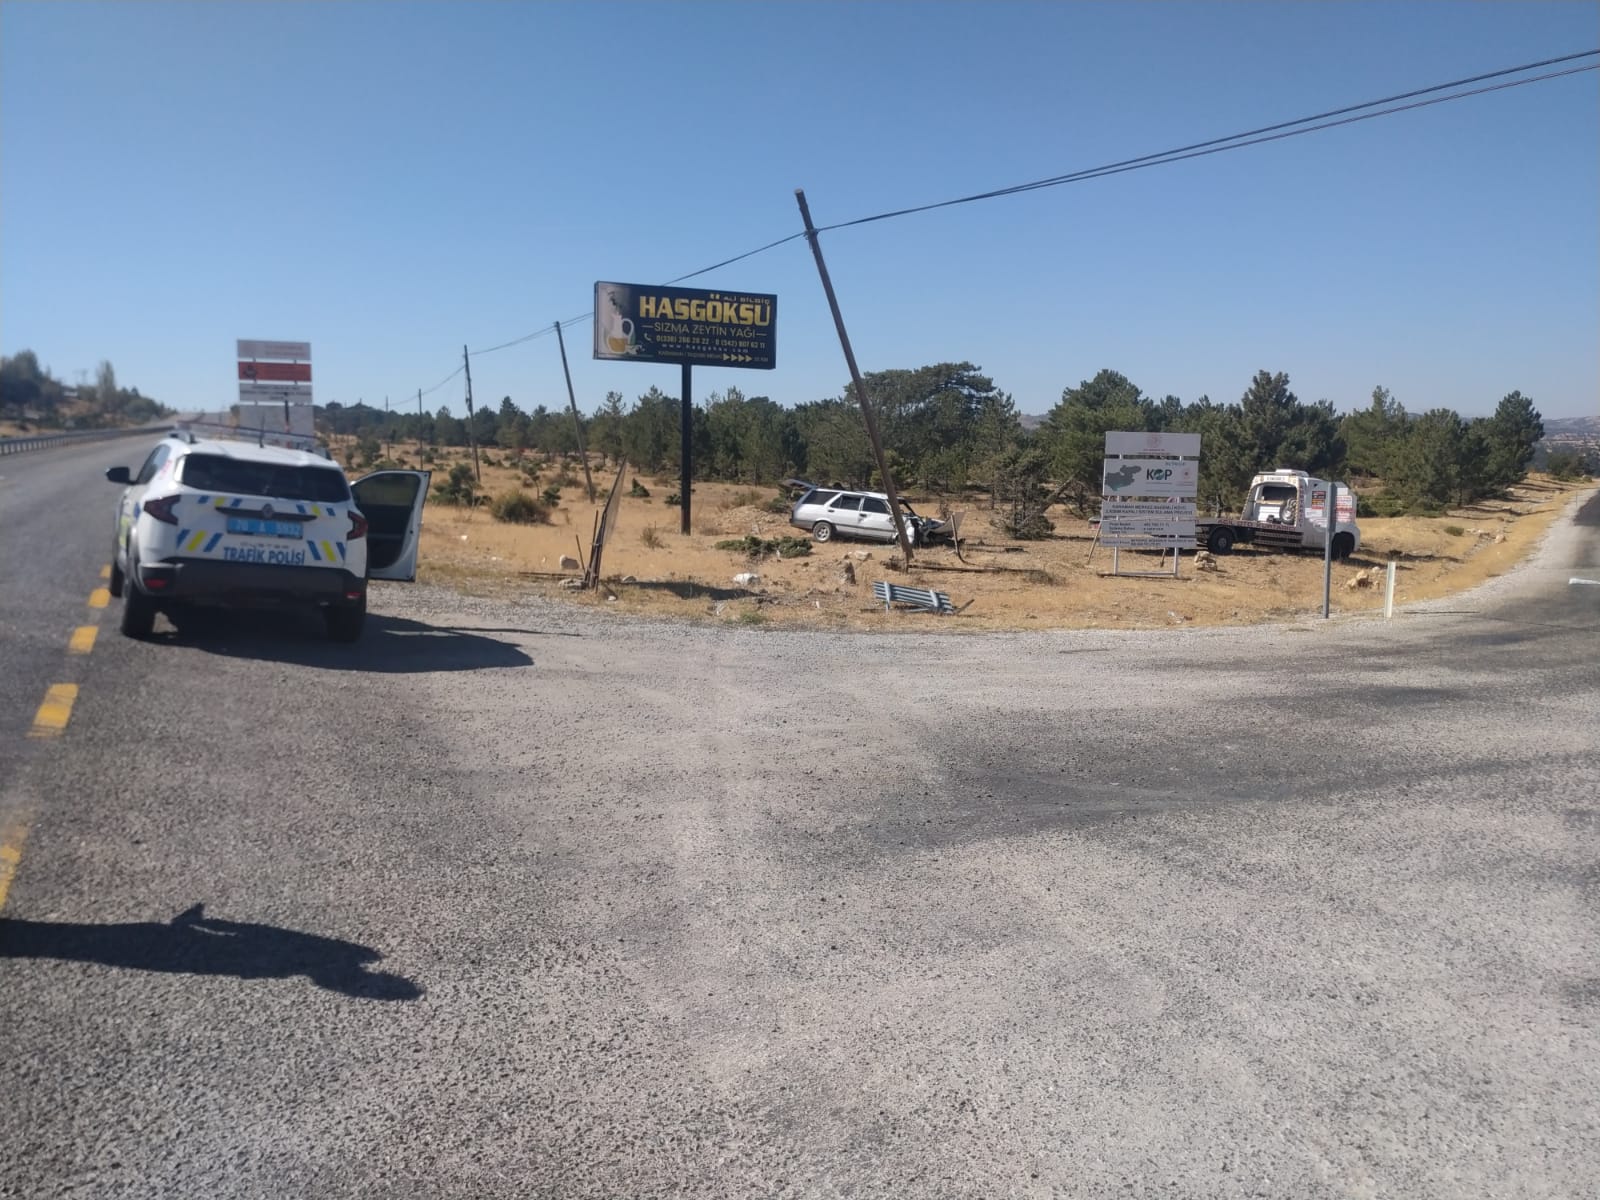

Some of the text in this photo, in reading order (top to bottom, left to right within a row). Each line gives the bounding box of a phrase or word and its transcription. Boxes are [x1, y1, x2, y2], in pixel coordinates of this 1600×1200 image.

[640, 294, 770, 326] HASGÖKSU
[654, 322, 755, 338] SIZMA ZEYTİN YAĞI
[224, 546, 305, 565] TRAFİK POLİSİ
